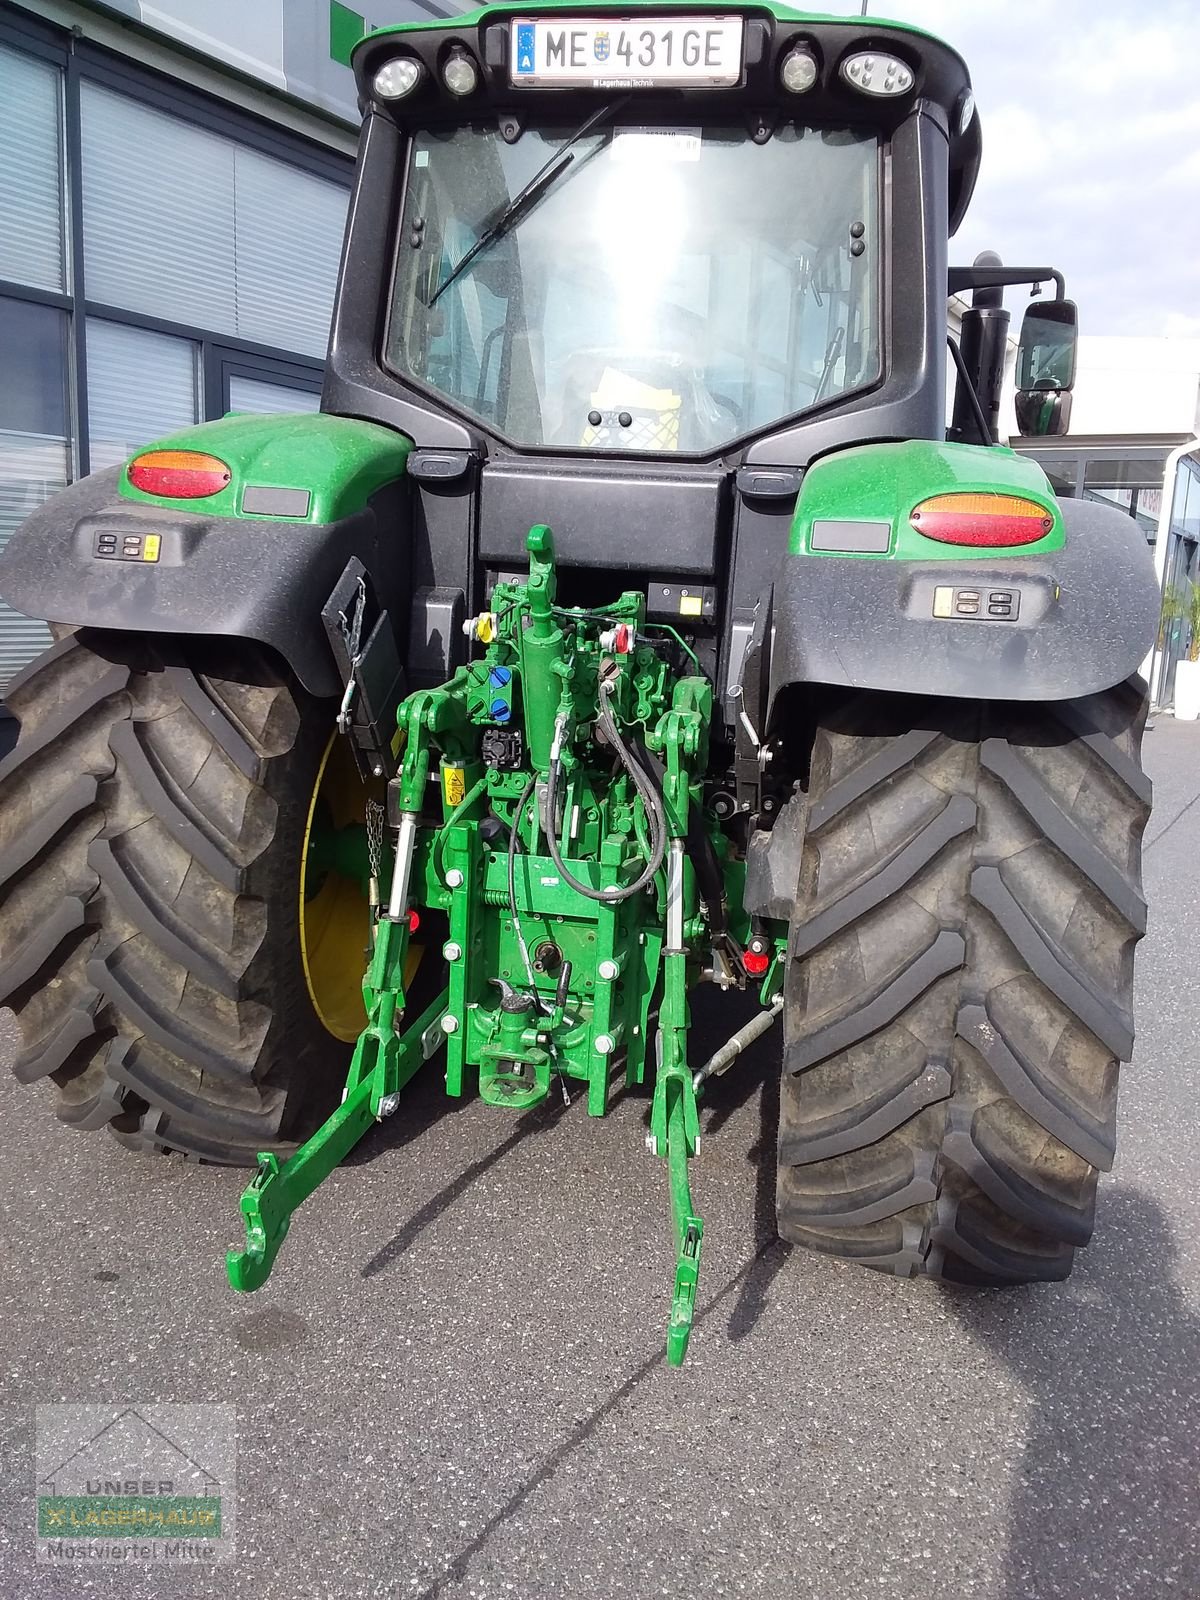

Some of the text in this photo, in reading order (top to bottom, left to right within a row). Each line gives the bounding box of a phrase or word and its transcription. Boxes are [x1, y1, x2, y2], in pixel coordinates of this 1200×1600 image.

[546, 30, 724, 67] ME 431GE
[521, 55, 532, 68] A
